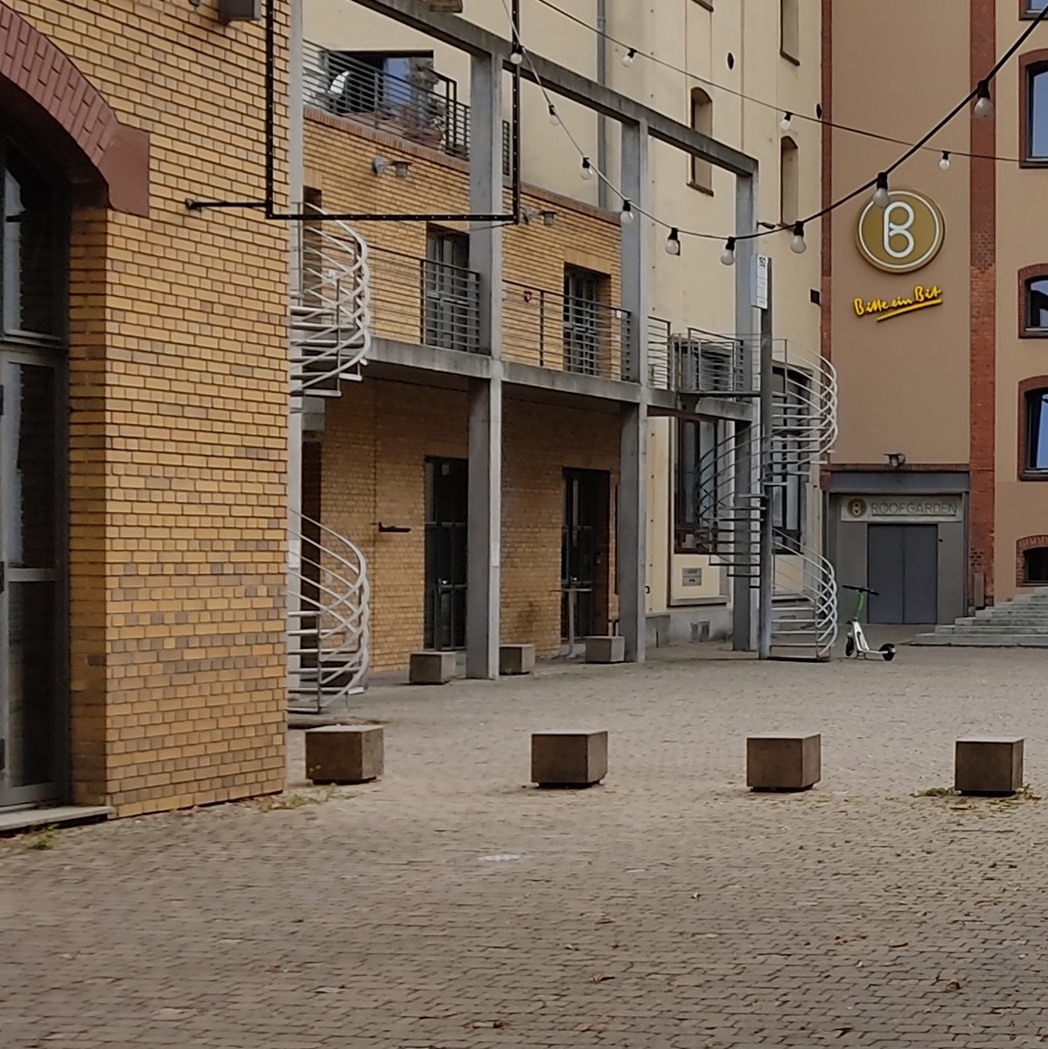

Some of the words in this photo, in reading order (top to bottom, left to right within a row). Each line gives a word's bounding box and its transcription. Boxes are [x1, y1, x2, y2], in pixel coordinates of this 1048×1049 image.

[883, 201, 915, 258] B
[853, 297, 888, 316] Bitte
[891, 296, 913, 308] ein
[914, 285, 942, 302] Bit
[871, 502, 957, 514] ROOFGARDEN
